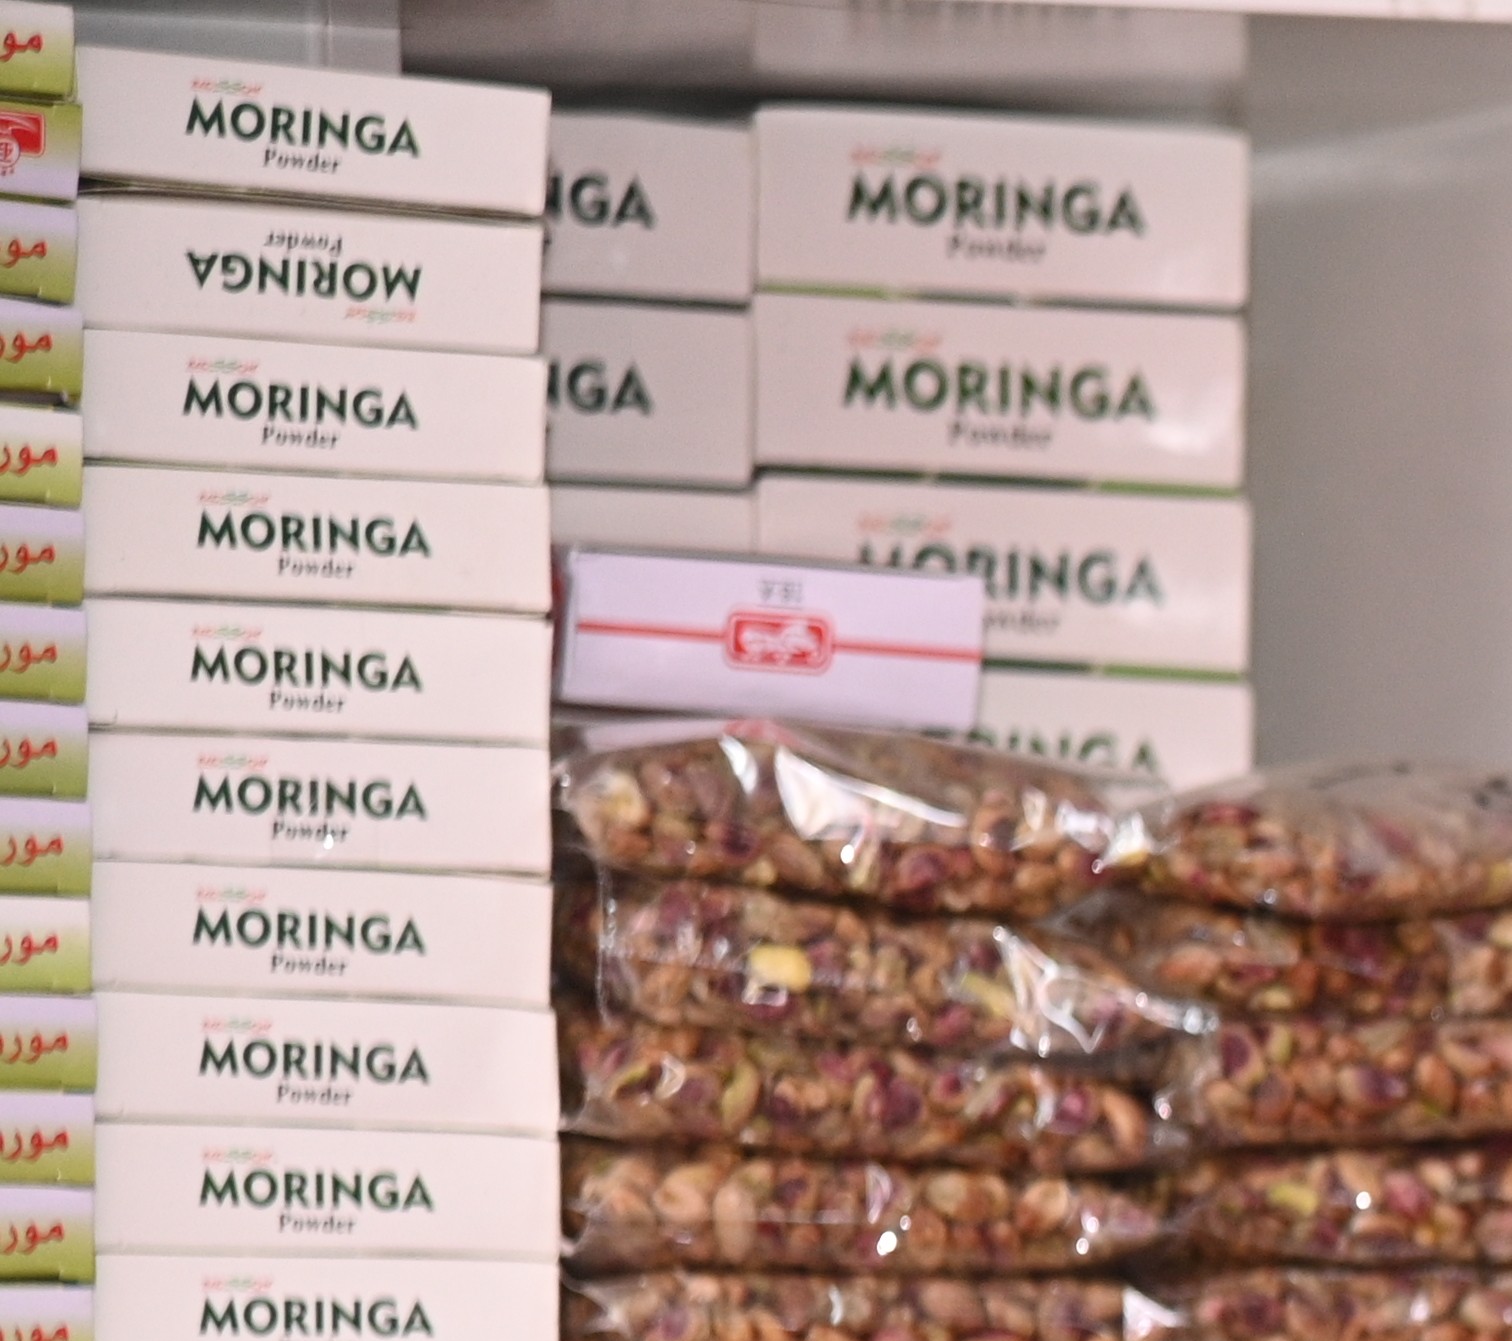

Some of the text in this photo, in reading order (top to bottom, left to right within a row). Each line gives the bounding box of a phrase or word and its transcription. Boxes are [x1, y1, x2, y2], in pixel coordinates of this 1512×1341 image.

[186, 97, 420, 158] MORINGA
[262, 148, 340, 174] Powder
[846, 169, 1146, 239] MORINGA
[265, 232, 343, 257] Powder
[187, 250, 421, 301] MORINGA
[183, 377, 418, 430] MORINGA
[842, 355, 1156, 424] MORINGA
[261, 425, 340, 450] Powder
[197, 508, 431, 558] MORINGA
[277, 555, 355, 579] Powder
[190, 644, 422, 692] MORINGA
[269, 691, 344, 714] Powder
[193, 773, 427, 821] MORINGA
[272, 820, 350, 844] Powder
[193, 908, 426, 956] MORINGA
[270, 954, 347, 977] Powder
[199, 1038, 429, 1086] MORINGA
[276, 1084, 352, 1107] Powder
[199, 1168, 434, 1213] MORINGA
[278, 1213, 356, 1236] Powder
[199, 1296, 433, 1338] MORINGA
